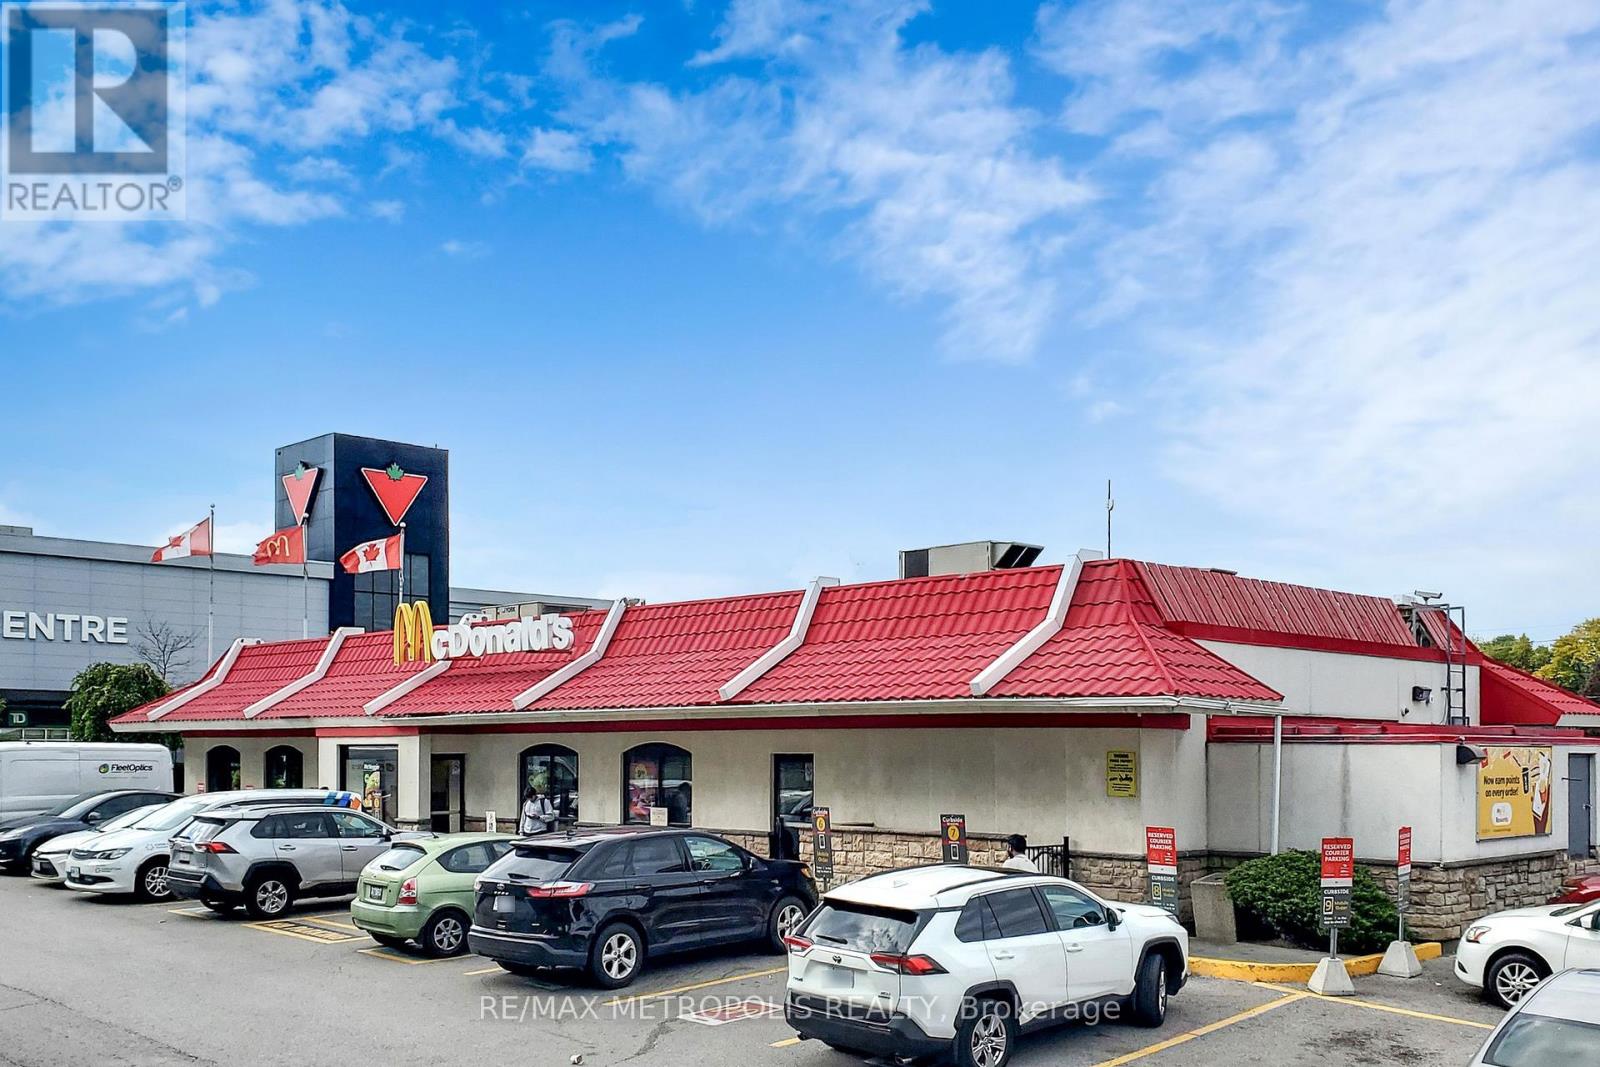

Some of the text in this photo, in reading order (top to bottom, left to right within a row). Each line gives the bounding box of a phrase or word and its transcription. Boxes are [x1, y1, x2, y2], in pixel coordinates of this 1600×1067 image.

[3, 610, 128, 644] ENTRE
[393, 600, 575, 667] McDonald's
[9, 712, 26, 723] TD
[111, 763, 153, 772] FleetOptics
[1484, 776, 1495, 785] Now
[1506, 776, 1520, 786] points
[1492, 789, 1504, 799] every
[950, 828, 956, 837] 7
[1153, 885, 1160, 897] 8
[1325, 900, 1332, 911] 9
